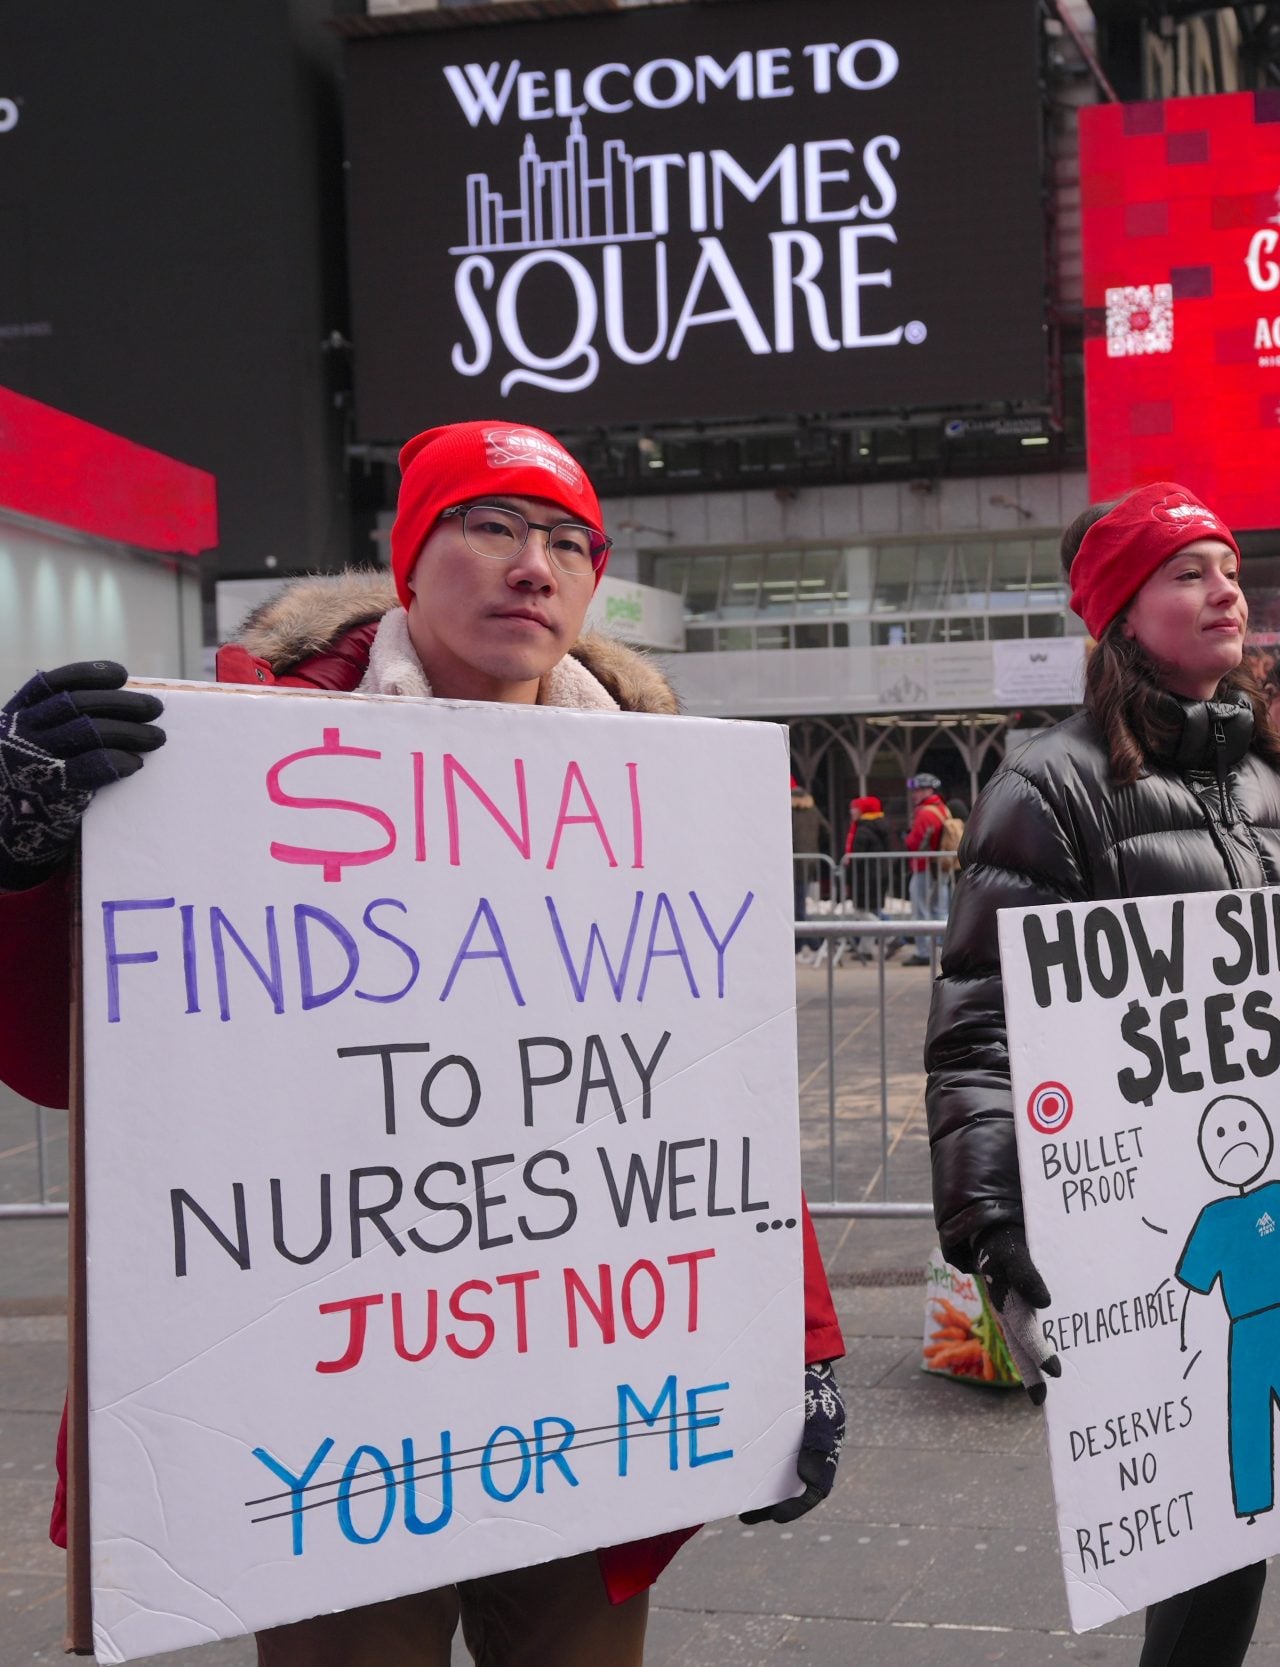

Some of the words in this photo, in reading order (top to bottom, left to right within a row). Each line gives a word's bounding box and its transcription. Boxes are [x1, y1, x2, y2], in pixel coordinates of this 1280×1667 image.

[443, 48, 794, 127] WELCOME
[803, 38, 899, 93] TO
[633, 135, 900, 234] TIMES
[266, 727, 646, 883] $INAI
[100, 896, 421, 1024] FINDS
[439, 896, 526, 1007] A
[545, 890, 755, 1004] WAY
[1022, 900, 1185, 1008] HOW
[337, 1042, 482, 1136] TO
[517, 1030, 672, 1128] PAY
[1041, 1126, 1143, 1180] BULLET
[1062, 1167, 1139, 1215] PROOF
[169, 1149, 578, 1278] NURSES
[596, 1136, 798, 1234] WELL...
[315, 1269, 540, 1374] JUST
[562, 1247, 717, 1348] NOT
[1042, 1289, 1179, 1354] REPLACEABLE
[250, 1429, 454, 1556] YOU
[480, 1415, 580, 1503] OR
[616, 1374, 734, 1478] ME
[1070, 1396, 1194, 1462] DESERVES
[1119, 1453, 1158, 1491] NO
[1077, 1492, 1196, 1573] RESPECT
